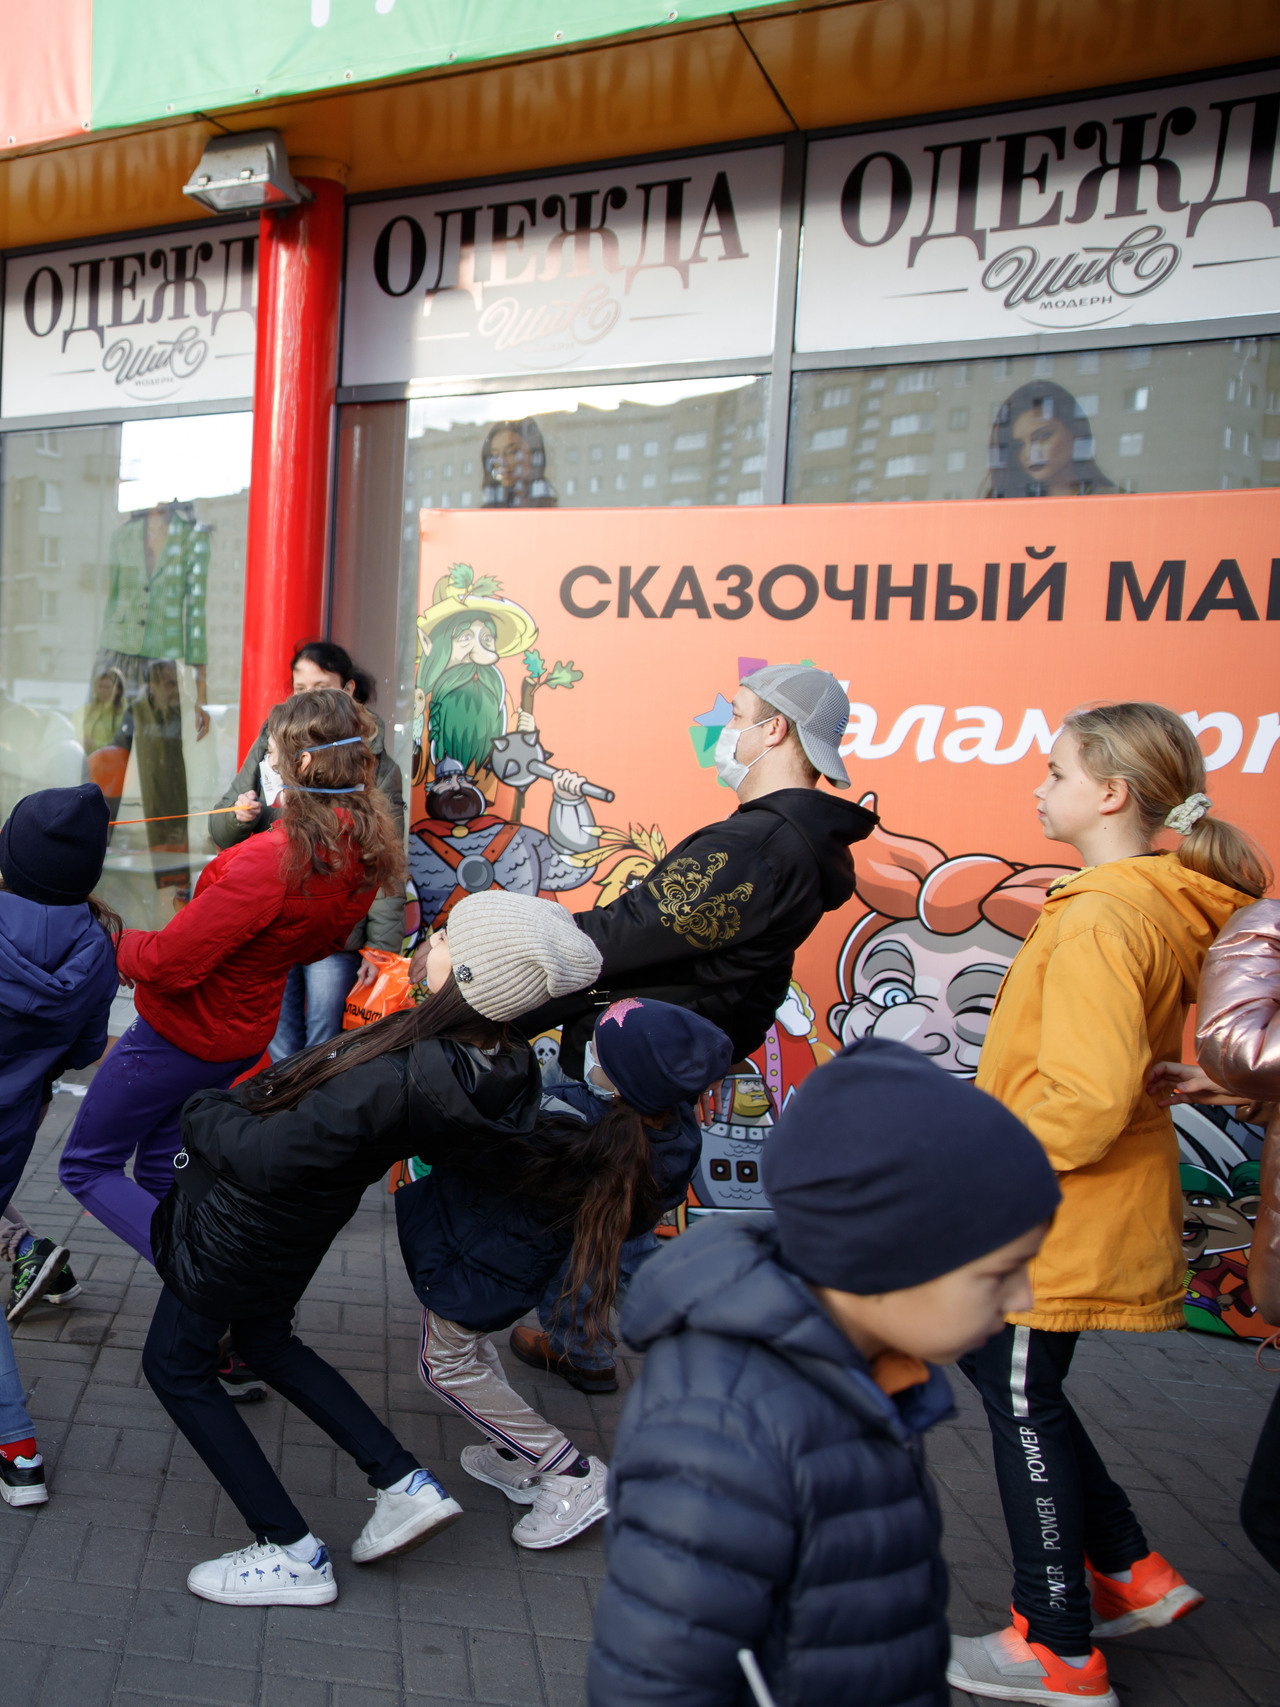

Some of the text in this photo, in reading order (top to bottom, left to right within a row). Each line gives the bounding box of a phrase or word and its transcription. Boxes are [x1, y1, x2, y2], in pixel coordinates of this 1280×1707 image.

[373, 170, 749, 316] ОДЕЖДА
[23, 235, 259, 353] ОДЕЖД
[1040, 295, 1113, 310] МОДЕРН
[559, 546, 1280, 622] СКАЗОЧНЫЙ МА
[1020, 1426, 1048, 1482] POWER
[1037, 1496, 1061, 1550] POWER
